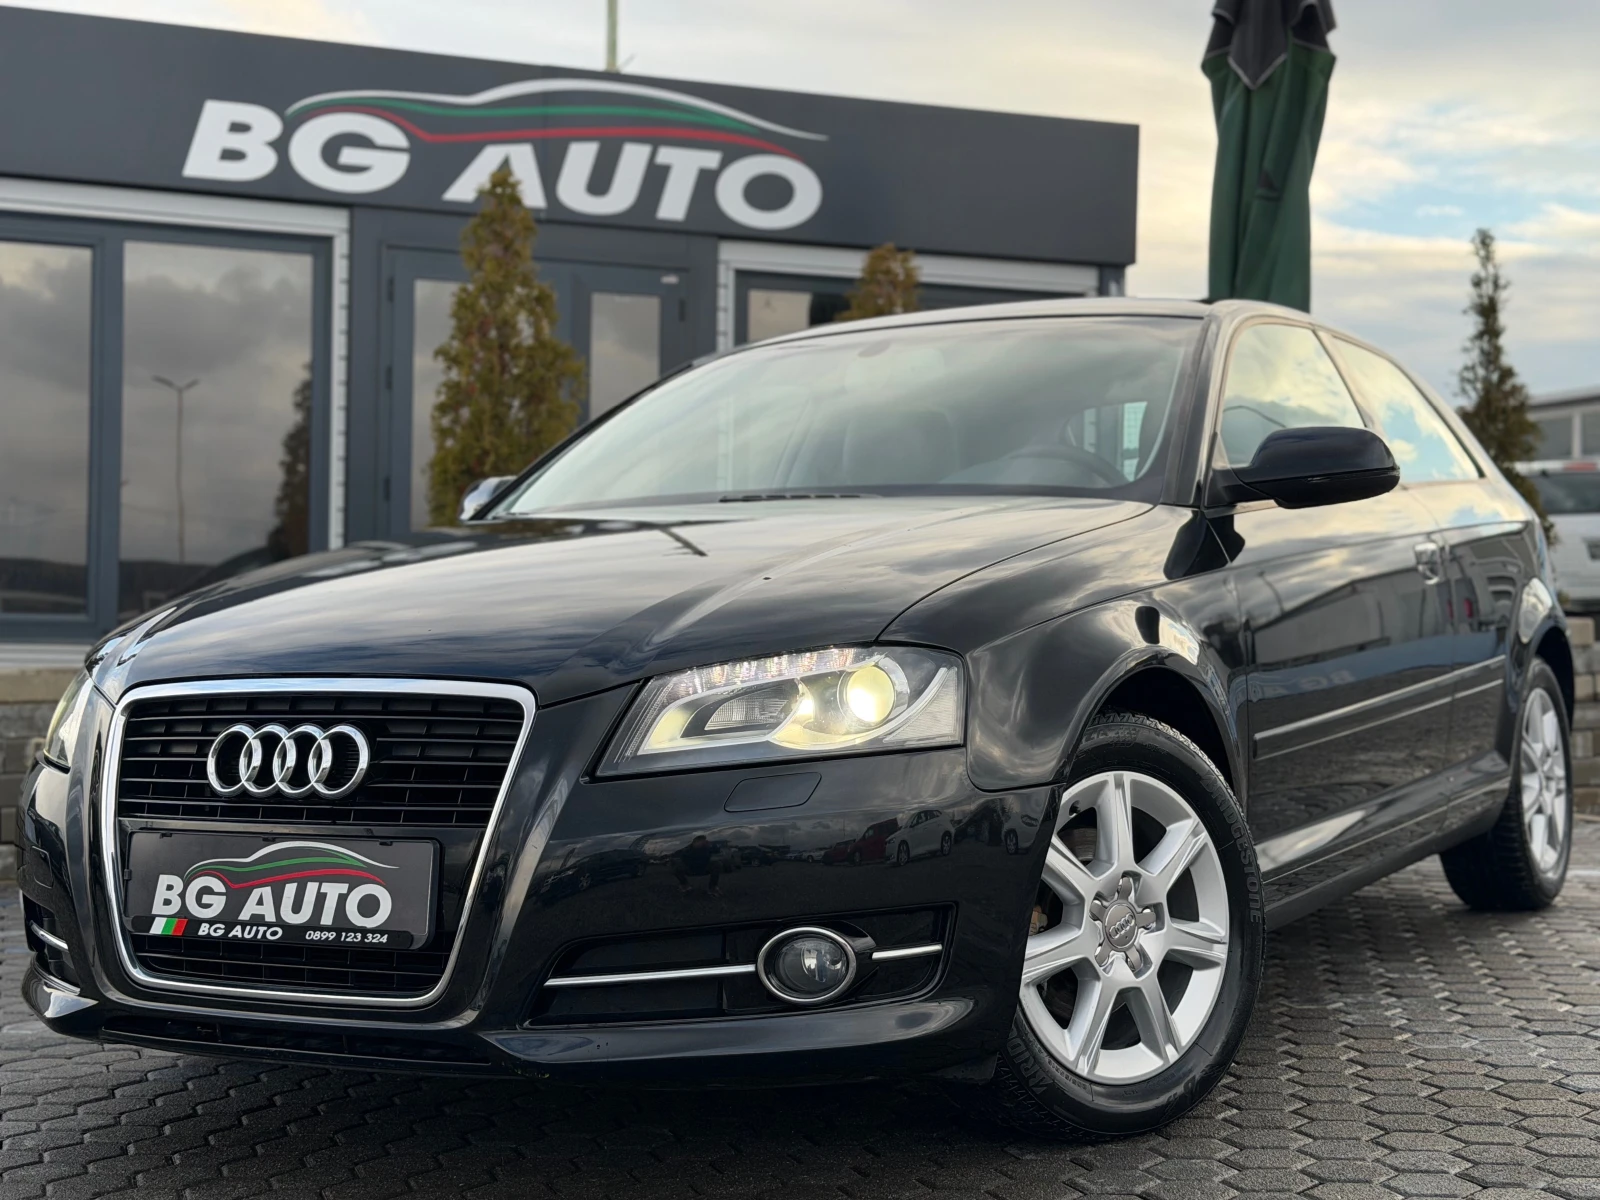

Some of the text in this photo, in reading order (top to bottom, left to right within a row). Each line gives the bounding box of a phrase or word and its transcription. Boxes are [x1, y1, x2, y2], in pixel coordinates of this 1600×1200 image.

[182, 99, 823, 230] BG AUTO
[1200, 770, 1263, 924] BRIDGESTONE
[151, 874, 393, 929] BG AUTO
[197, 922, 389, 944] BG AUTO 0899 123 324
